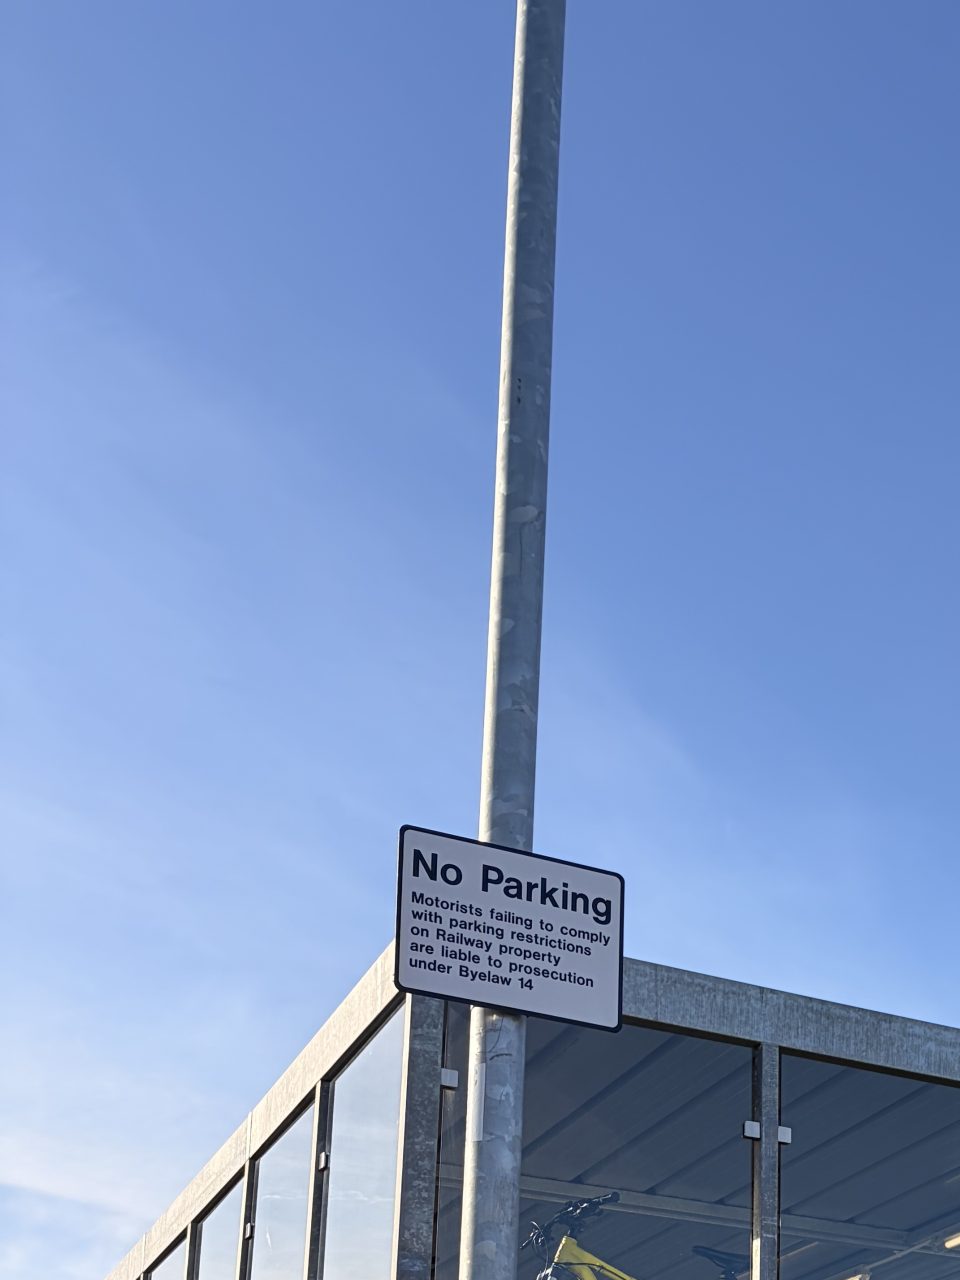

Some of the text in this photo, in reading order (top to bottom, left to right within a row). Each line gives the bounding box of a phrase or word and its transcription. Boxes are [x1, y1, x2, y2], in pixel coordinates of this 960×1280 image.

[412, 848, 612, 925] No Parking
[411, 891, 611, 946] Motorists failing to comply
[411, 909, 592, 956] with parking restrictions
[409, 941, 594, 988] are liable to prosecution
[410, 925, 561, 967] on Railway property
[409, 957, 534, 991] under Byelaw 14
